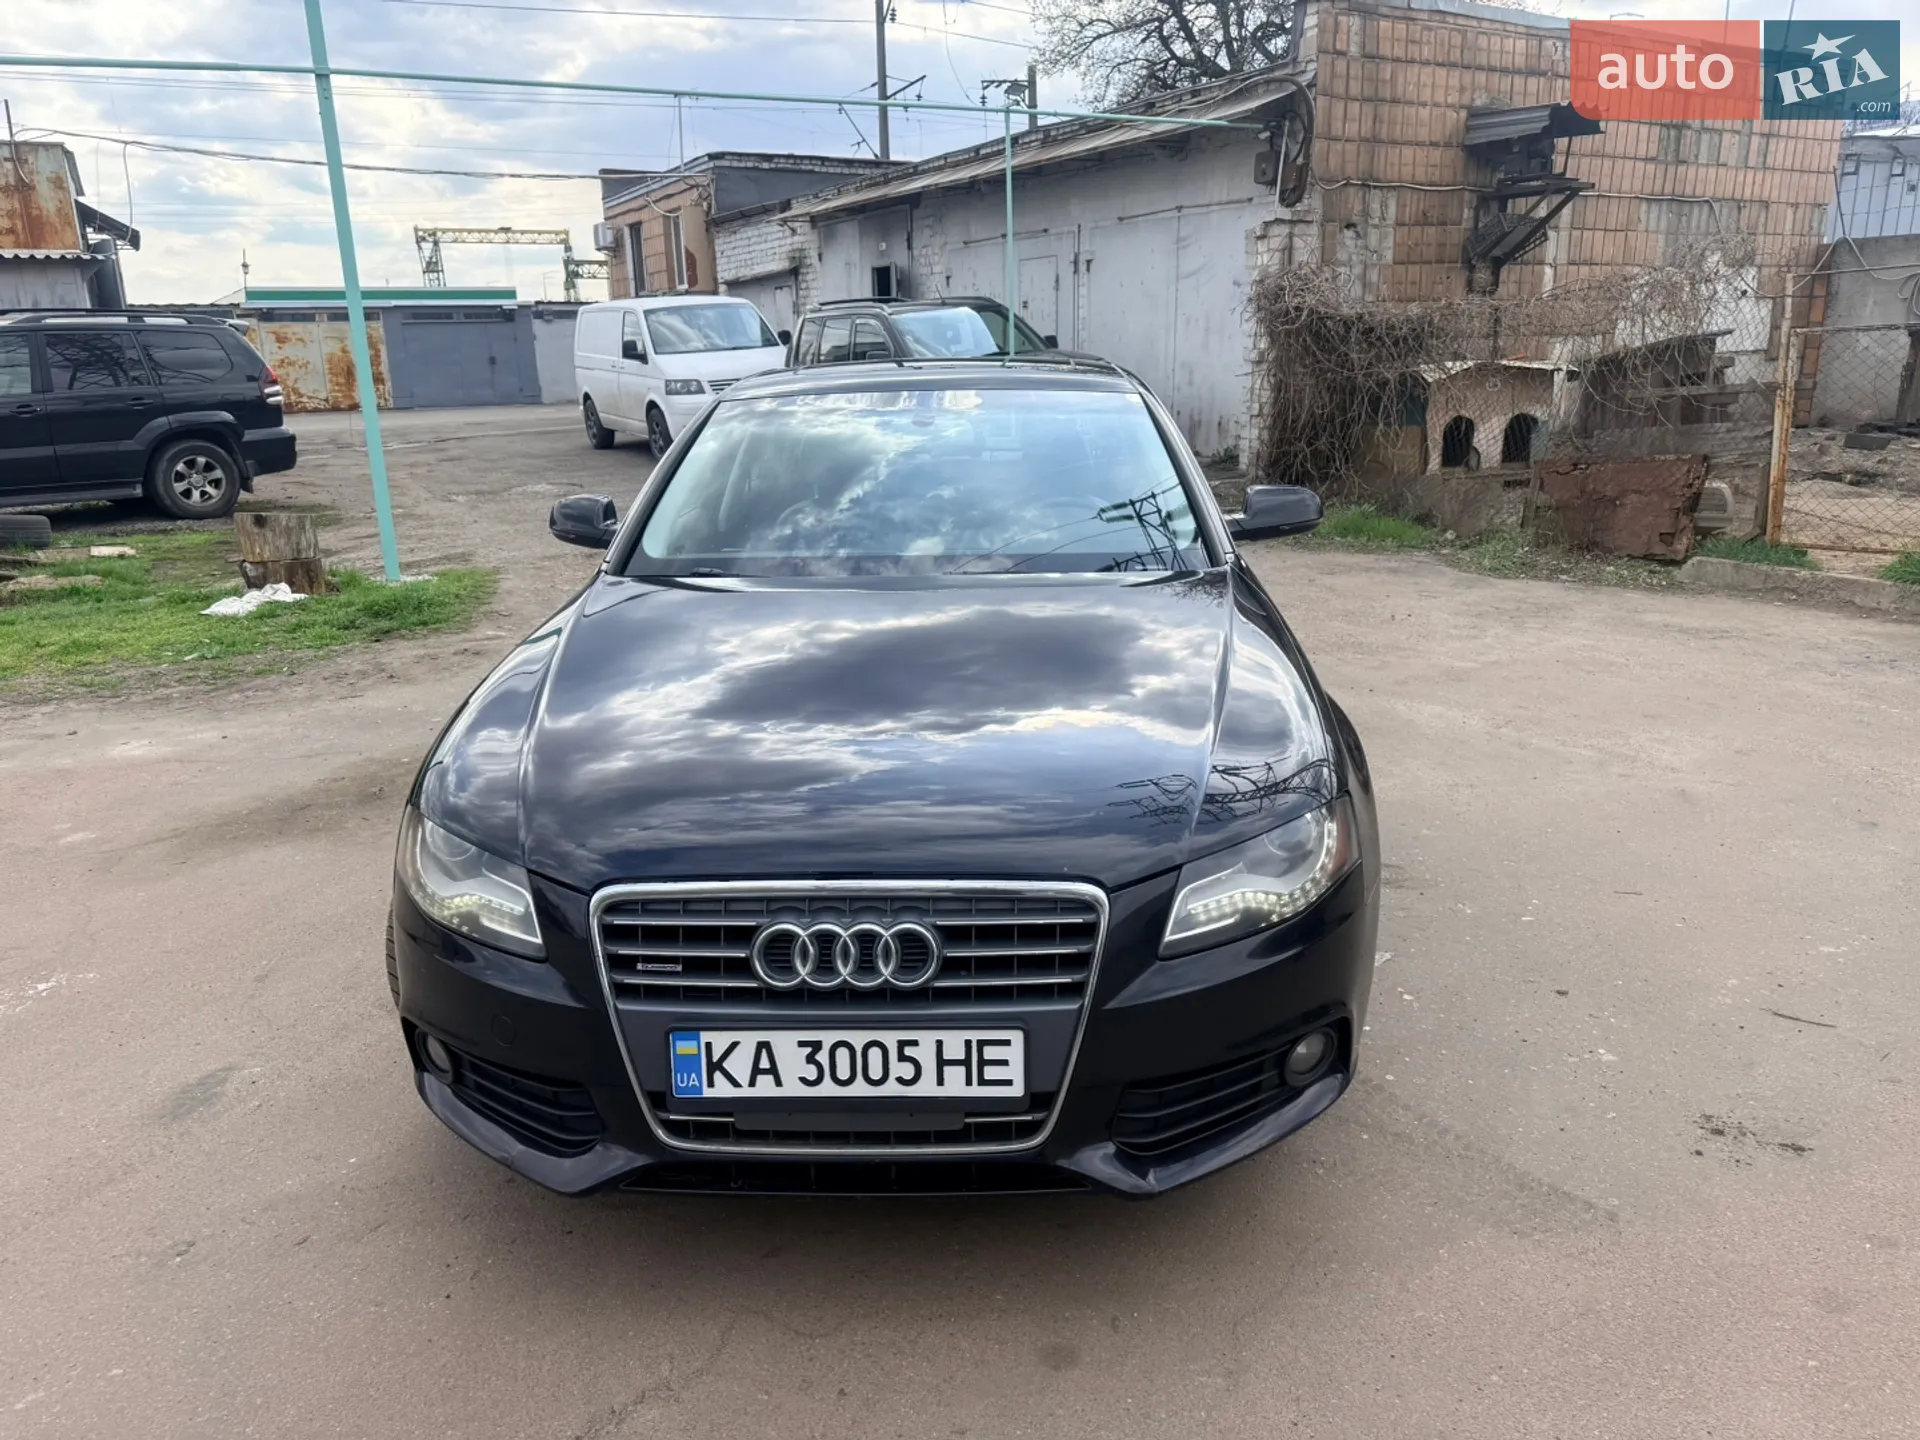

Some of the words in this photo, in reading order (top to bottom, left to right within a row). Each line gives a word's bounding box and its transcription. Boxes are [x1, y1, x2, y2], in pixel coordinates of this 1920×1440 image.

[676, 1072, 700, 1088] UA
[704, 1040, 783, 1089] KA
[797, 1039, 923, 1088] 3005
[935, 1039, 1014, 1087] HE
